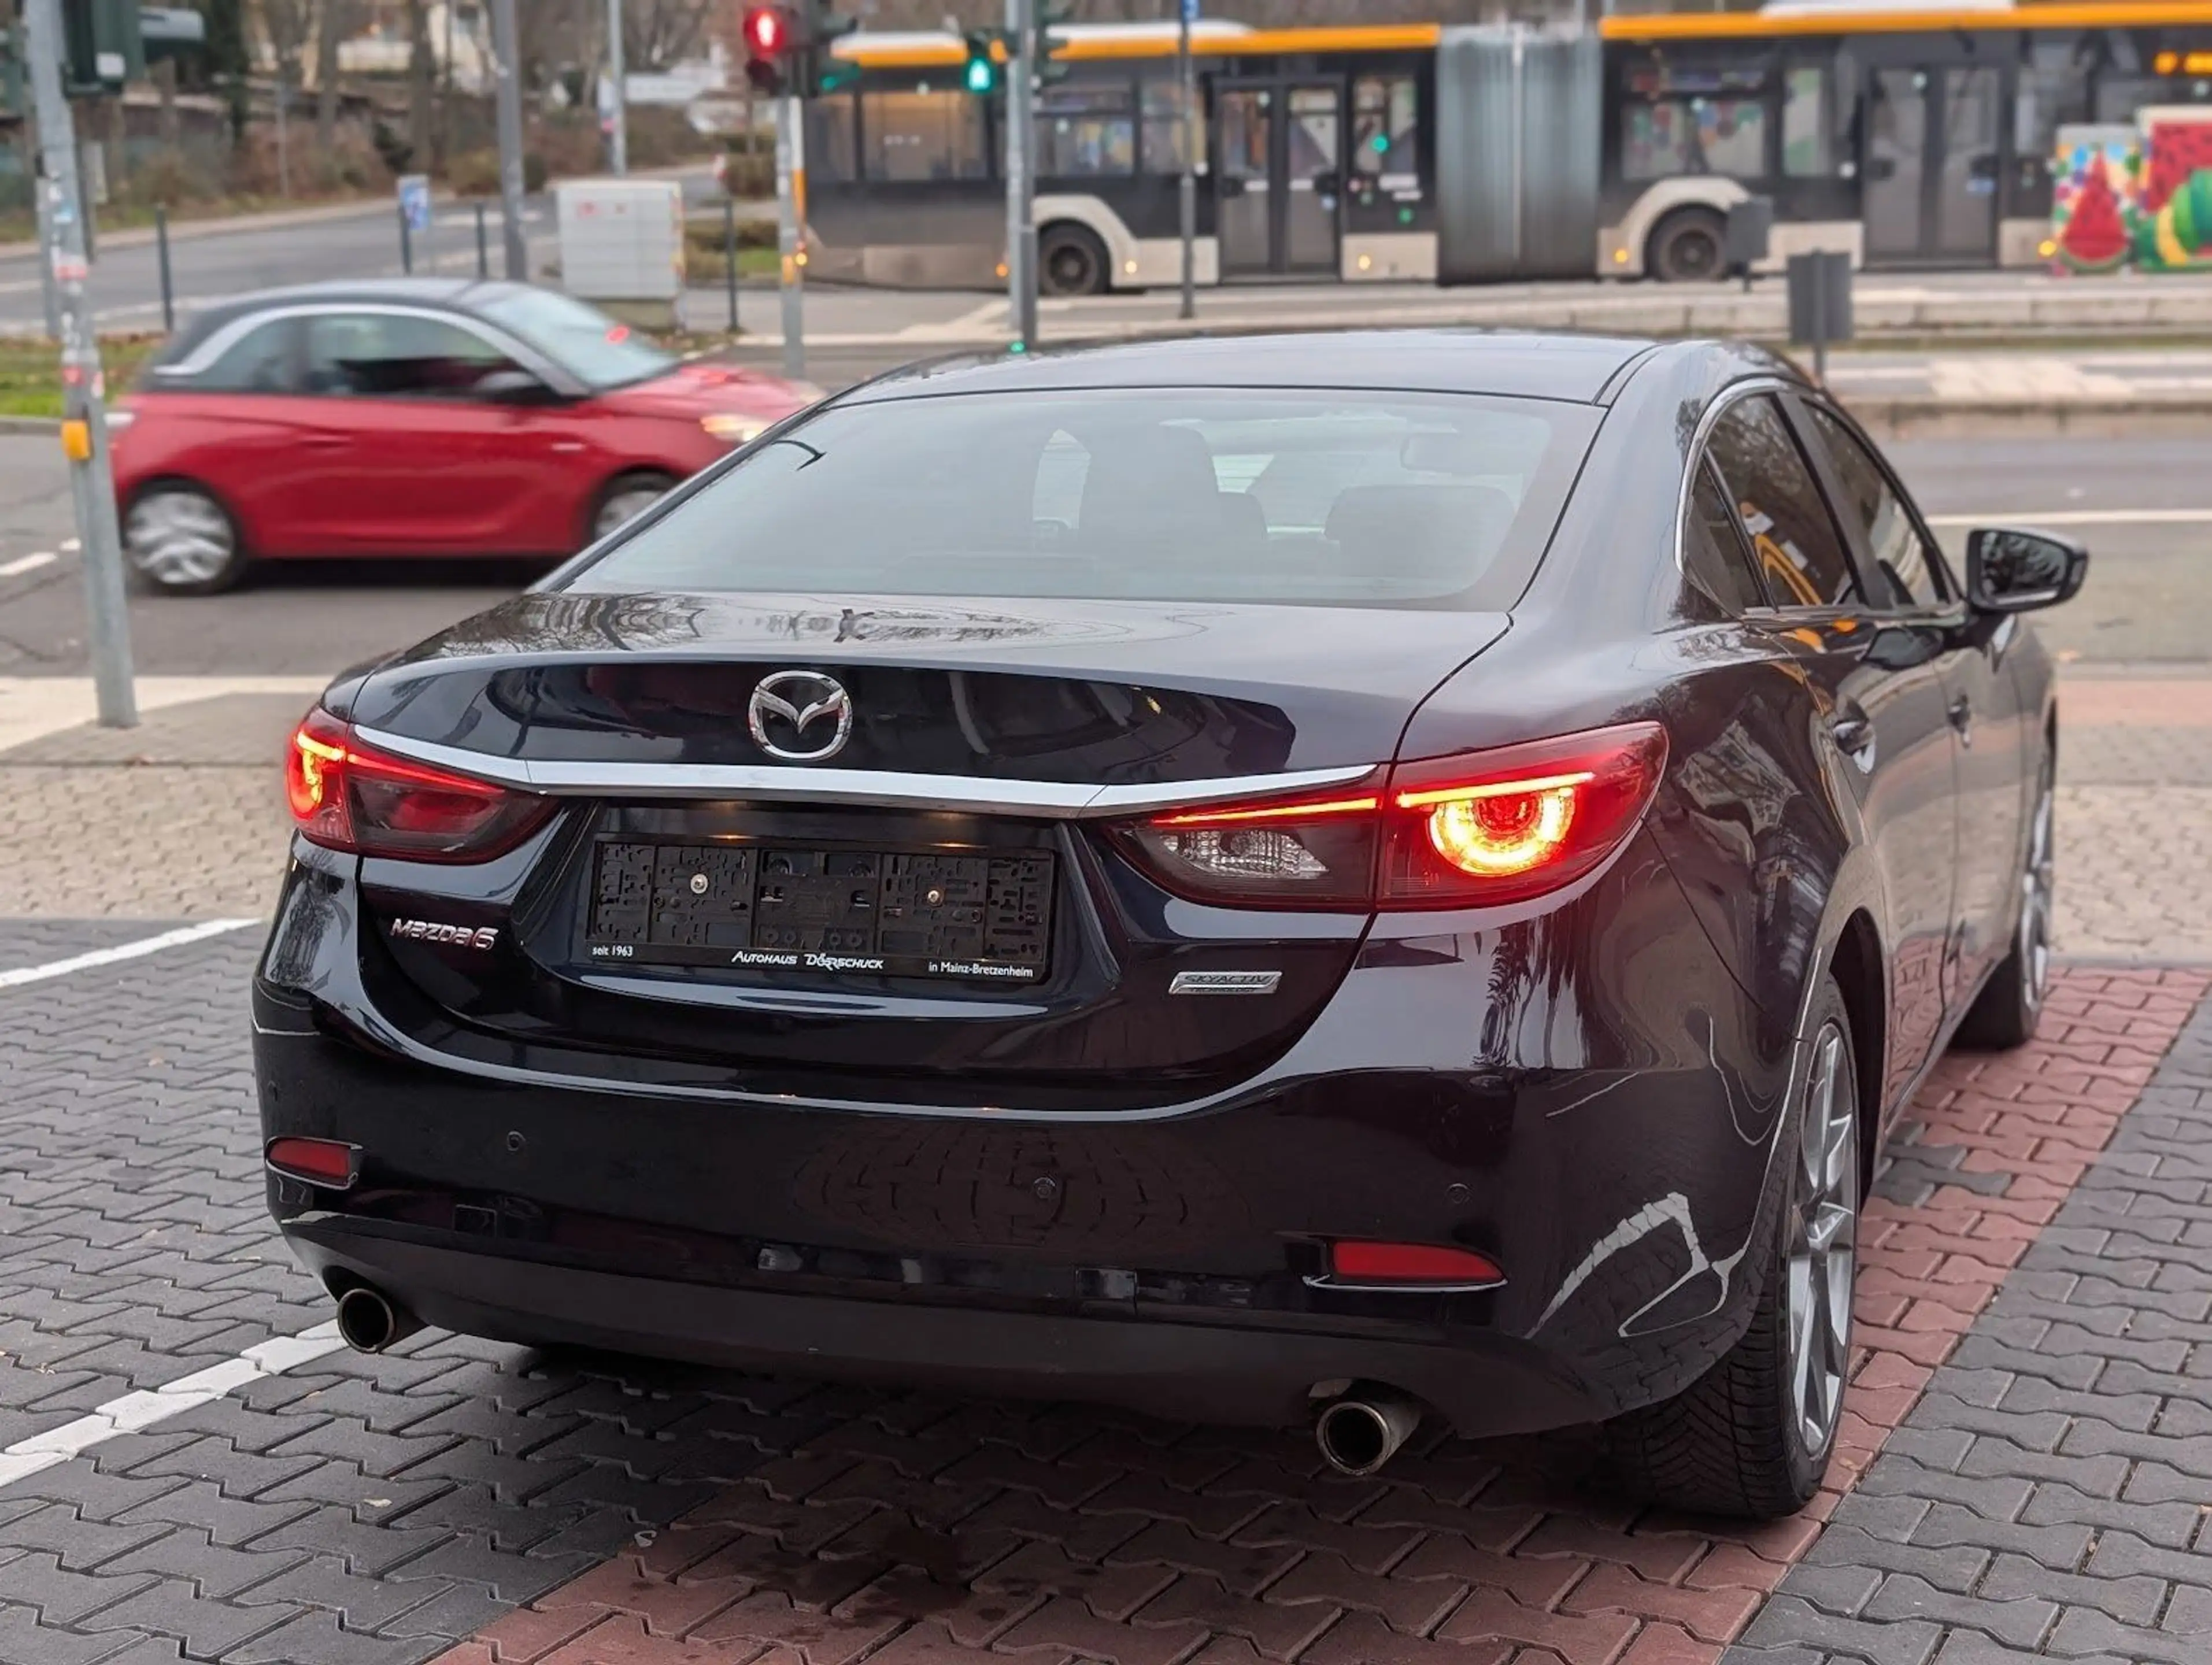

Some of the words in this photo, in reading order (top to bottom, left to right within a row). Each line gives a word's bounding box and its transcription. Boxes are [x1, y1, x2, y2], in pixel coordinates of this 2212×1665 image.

[592, 946, 608, 956] seit
[612, 946, 633, 957] 1963
[731, 950, 797, 964] AUTOHAUS
[929, 962, 937, 972] in
[940, 962, 1033, 977] Mainz-Bretzenheim
[1185, 974, 1271, 983] SKYACTIV
